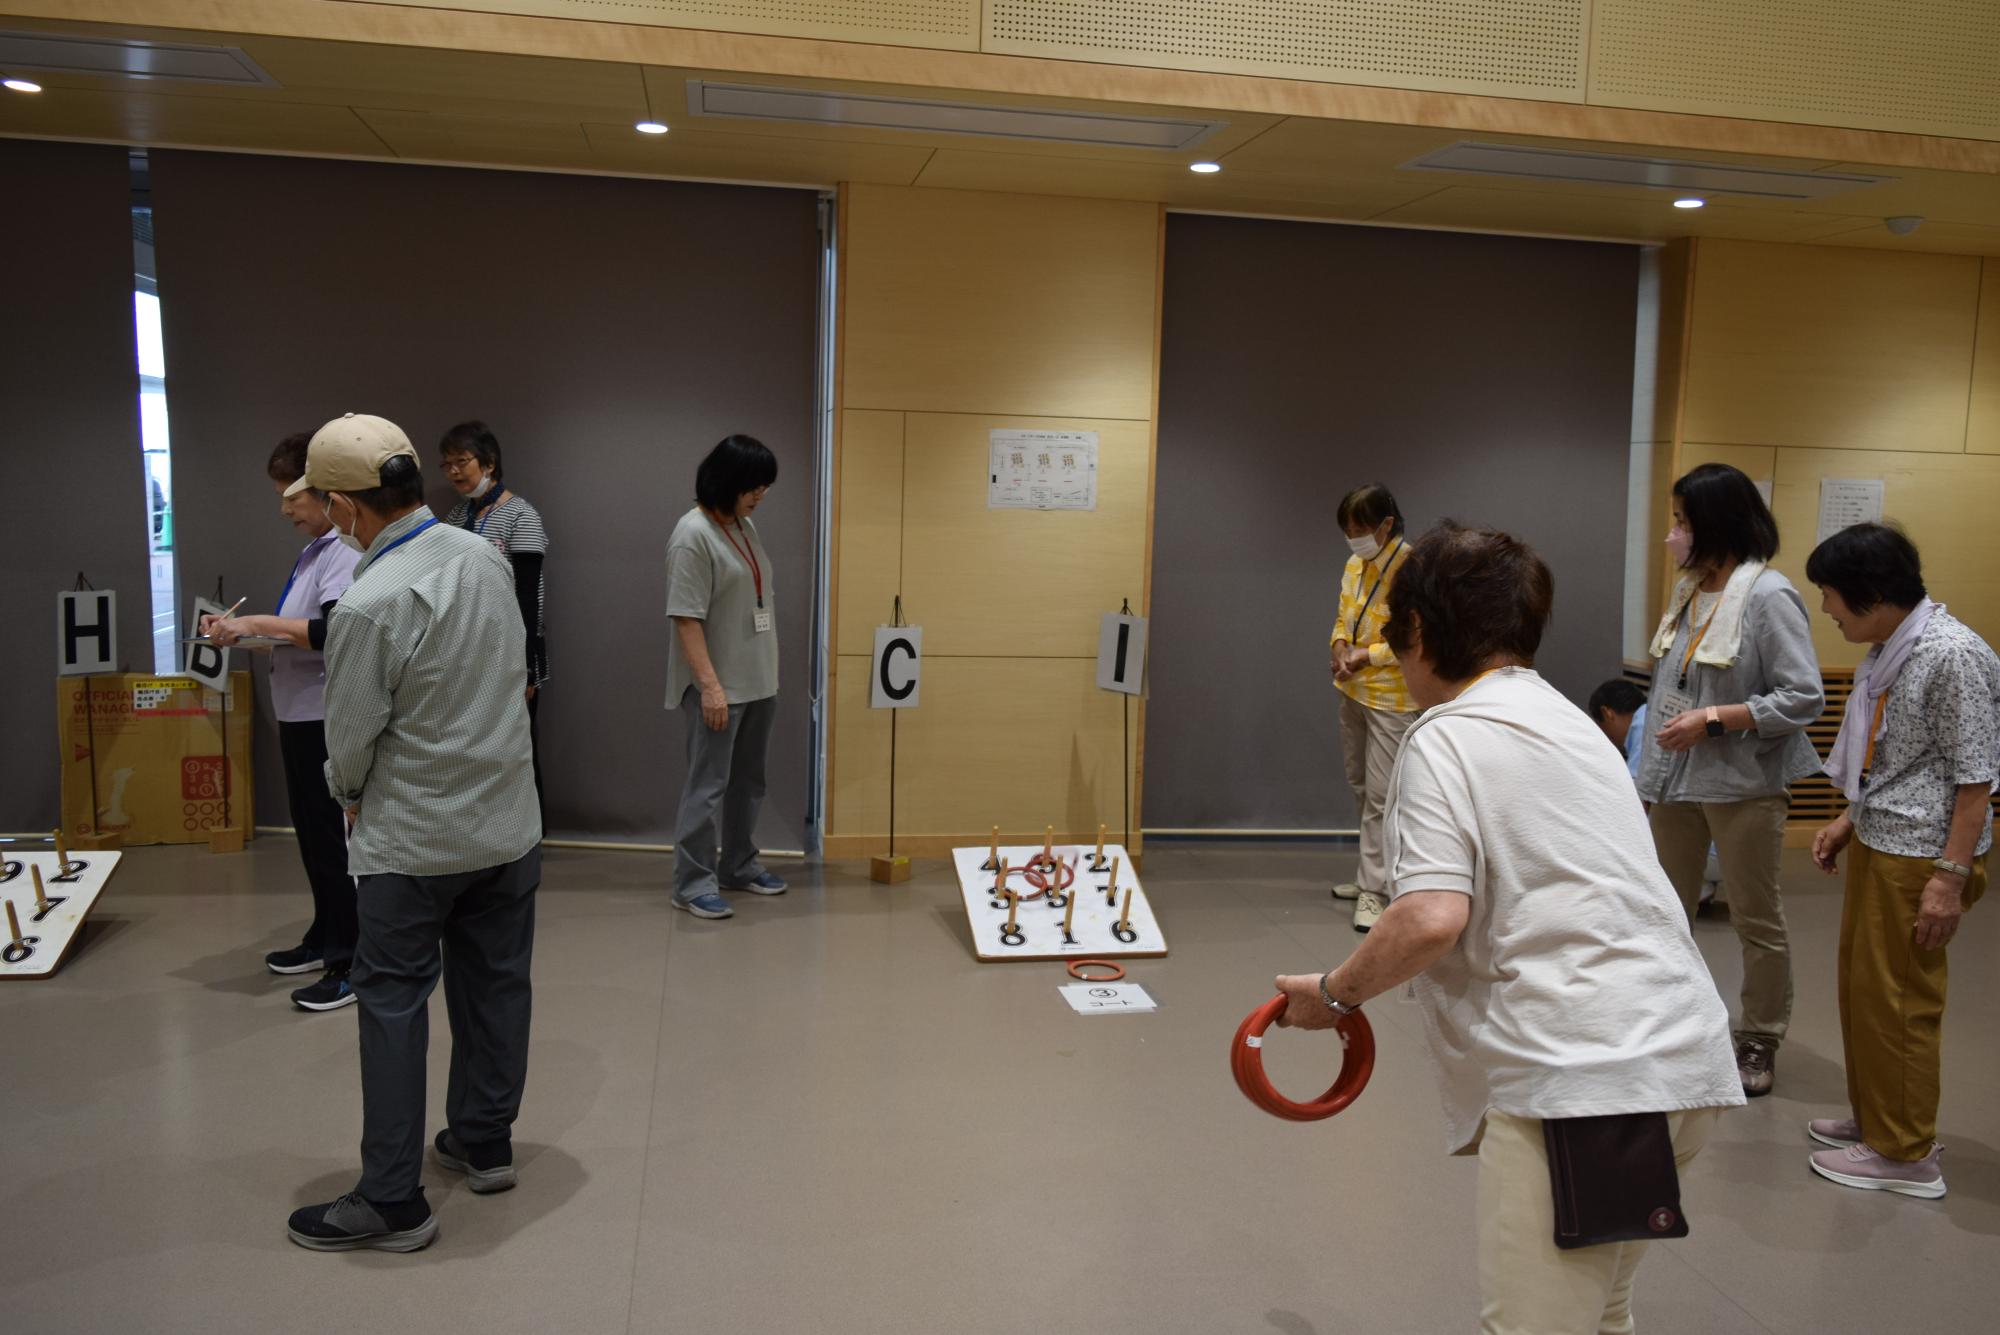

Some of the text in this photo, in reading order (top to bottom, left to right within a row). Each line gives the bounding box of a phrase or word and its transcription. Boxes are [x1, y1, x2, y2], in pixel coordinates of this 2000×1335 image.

[64, 597, 110, 664] H
[880, 638, 917, 700] C
[47, 860, 91, 883] 2
[1084, 853, 1112, 873] 2
[30, 896, 69, 923] 7
[1096, 886, 1118, 907] 7
[999, 920, 1138, 946] 8 1 6
[1, 936, 41, 963] 6
